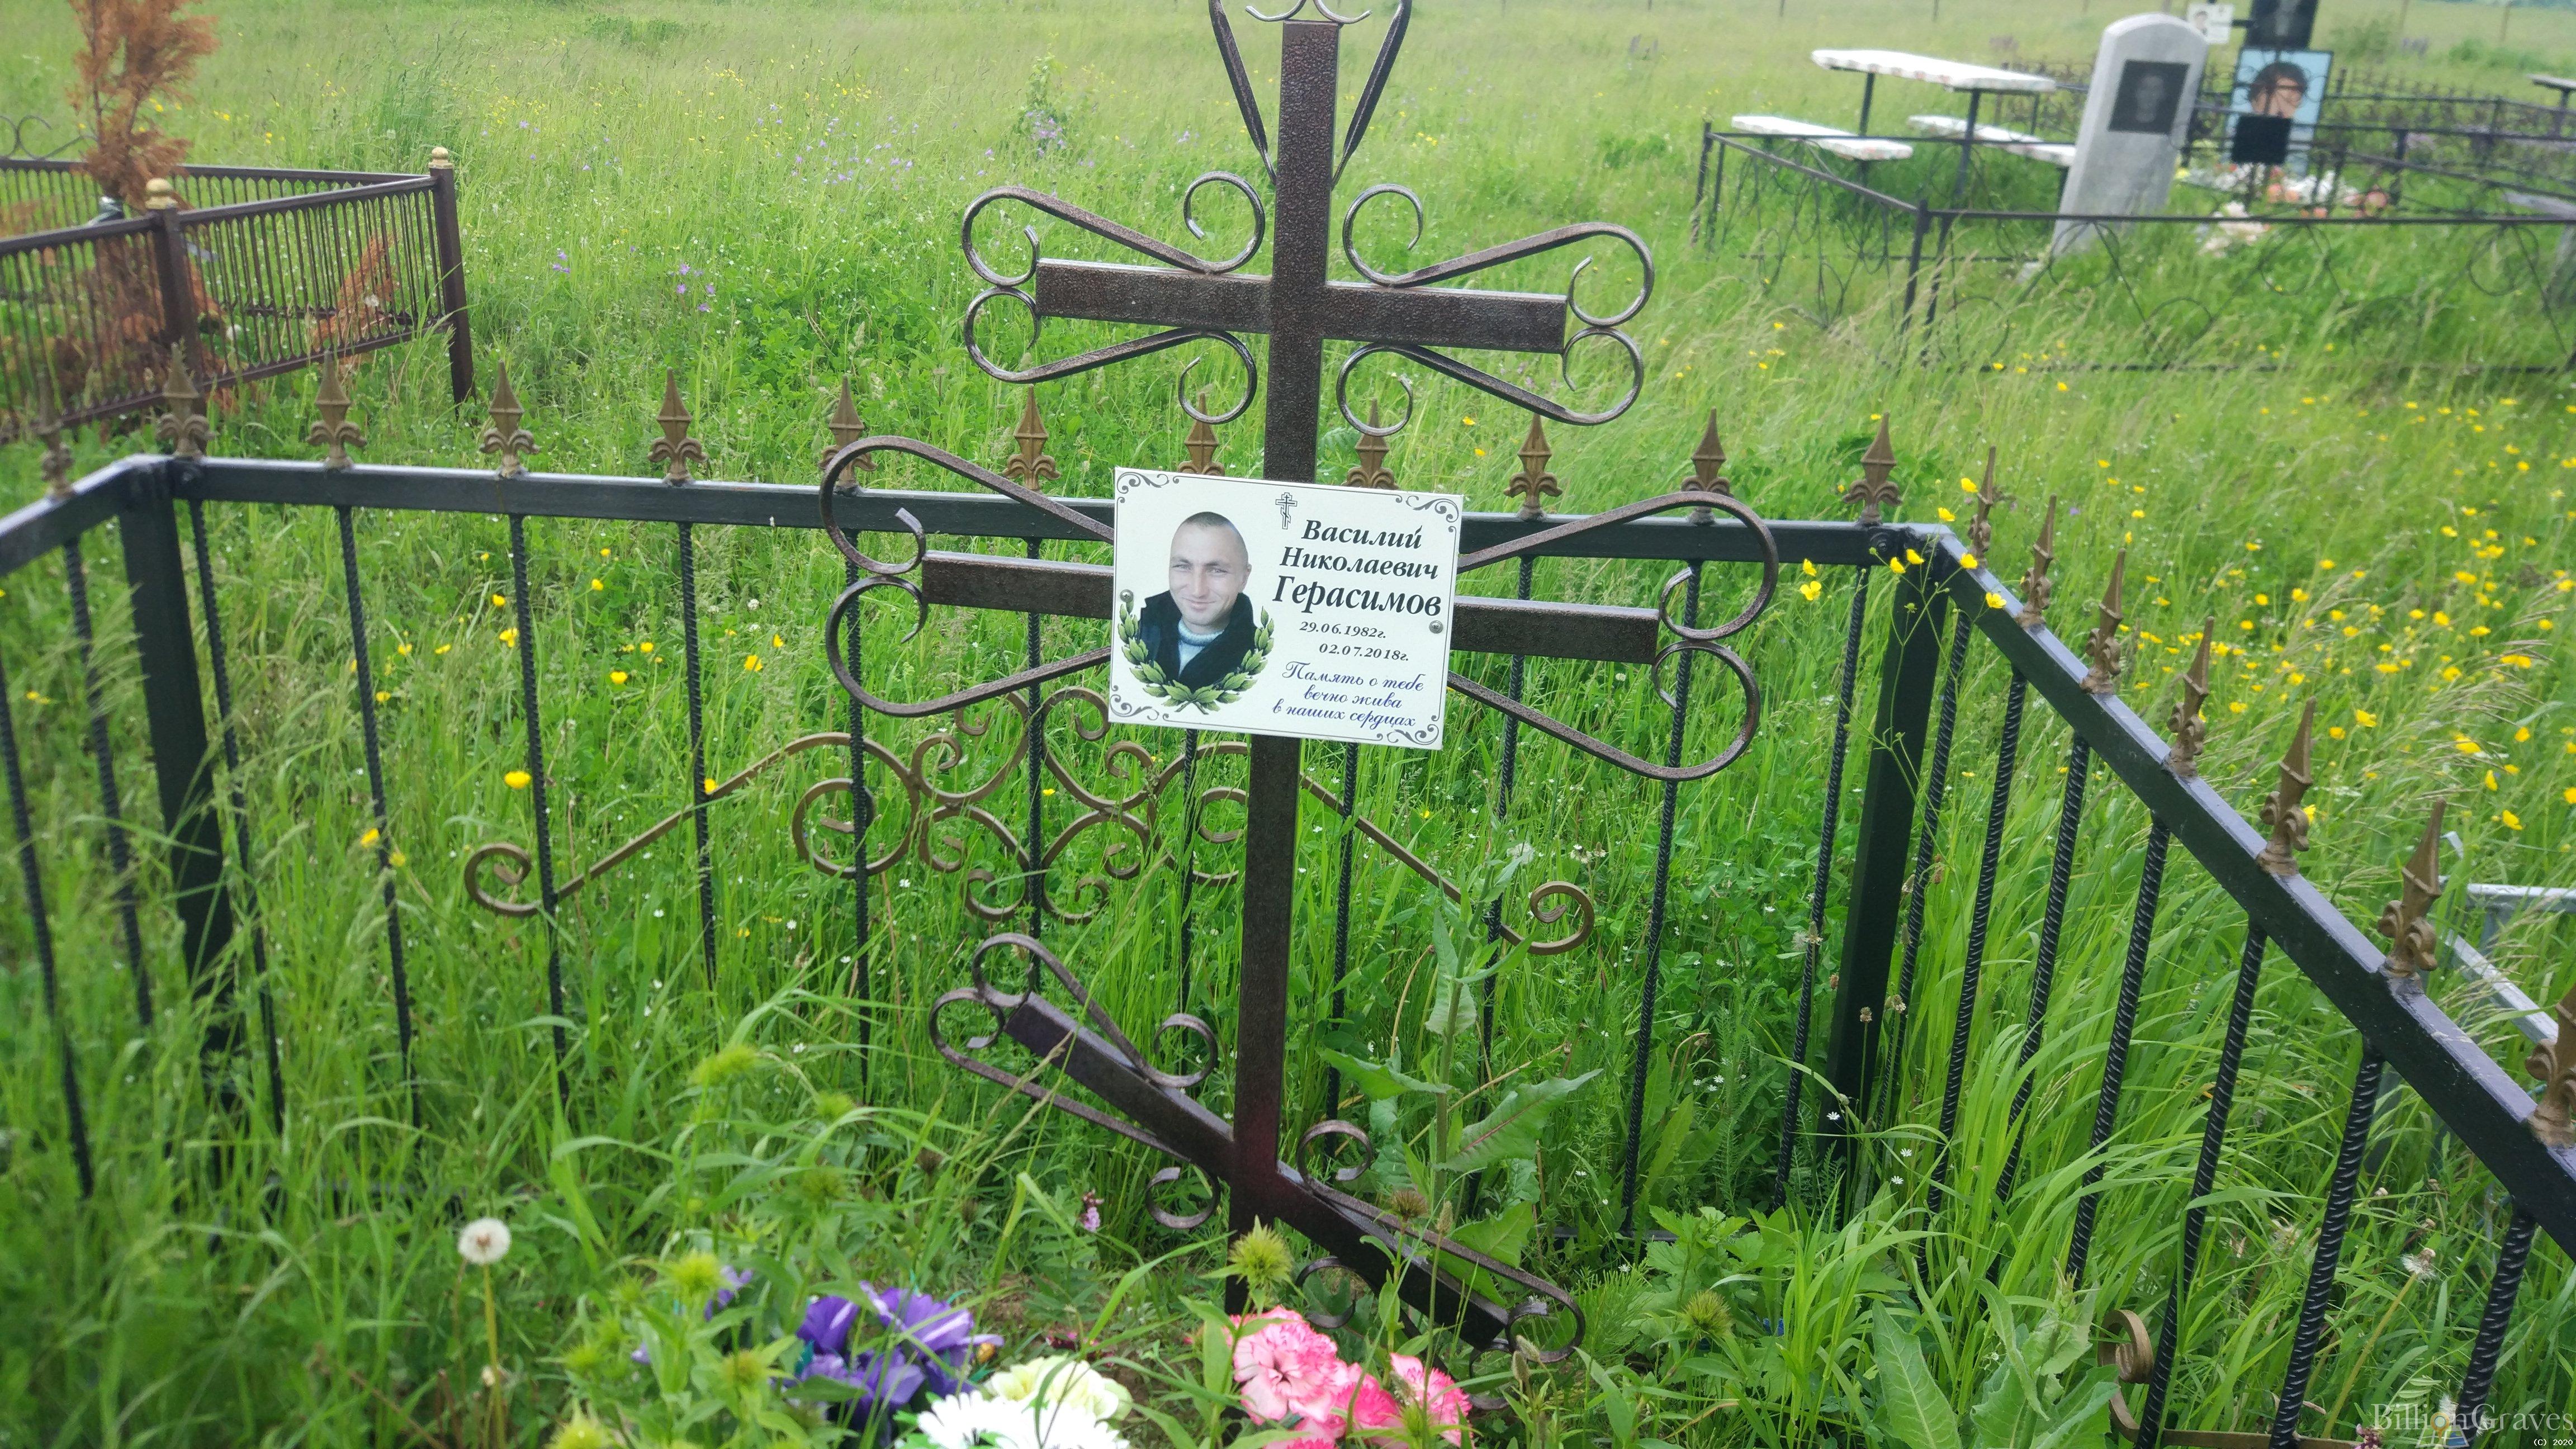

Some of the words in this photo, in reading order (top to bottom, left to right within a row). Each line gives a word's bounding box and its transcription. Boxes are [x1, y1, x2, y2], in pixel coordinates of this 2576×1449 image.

[1301, 519, 1423, 549] Василий
[1279, 546, 1438, 580] Николаевич
[1272, 575, 1442, 617] Герасимов
[1299, 621, 1386, 638] 29.06.1982г.
[1319, 643, 1409, 661] 02.07.2018г.
[1282, 661, 1364, 685] Память
[1368, 678, 1379, 687] о
[1382, 674, 1426, 692] тебе
[1304, 684, 1348, 703] вечно
[1352, 692, 1403, 709] жива
[1272, 698, 1285, 714] в
[1286, 706, 1346, 720] наших
[1349, 710, 1416, 730] сердцах
